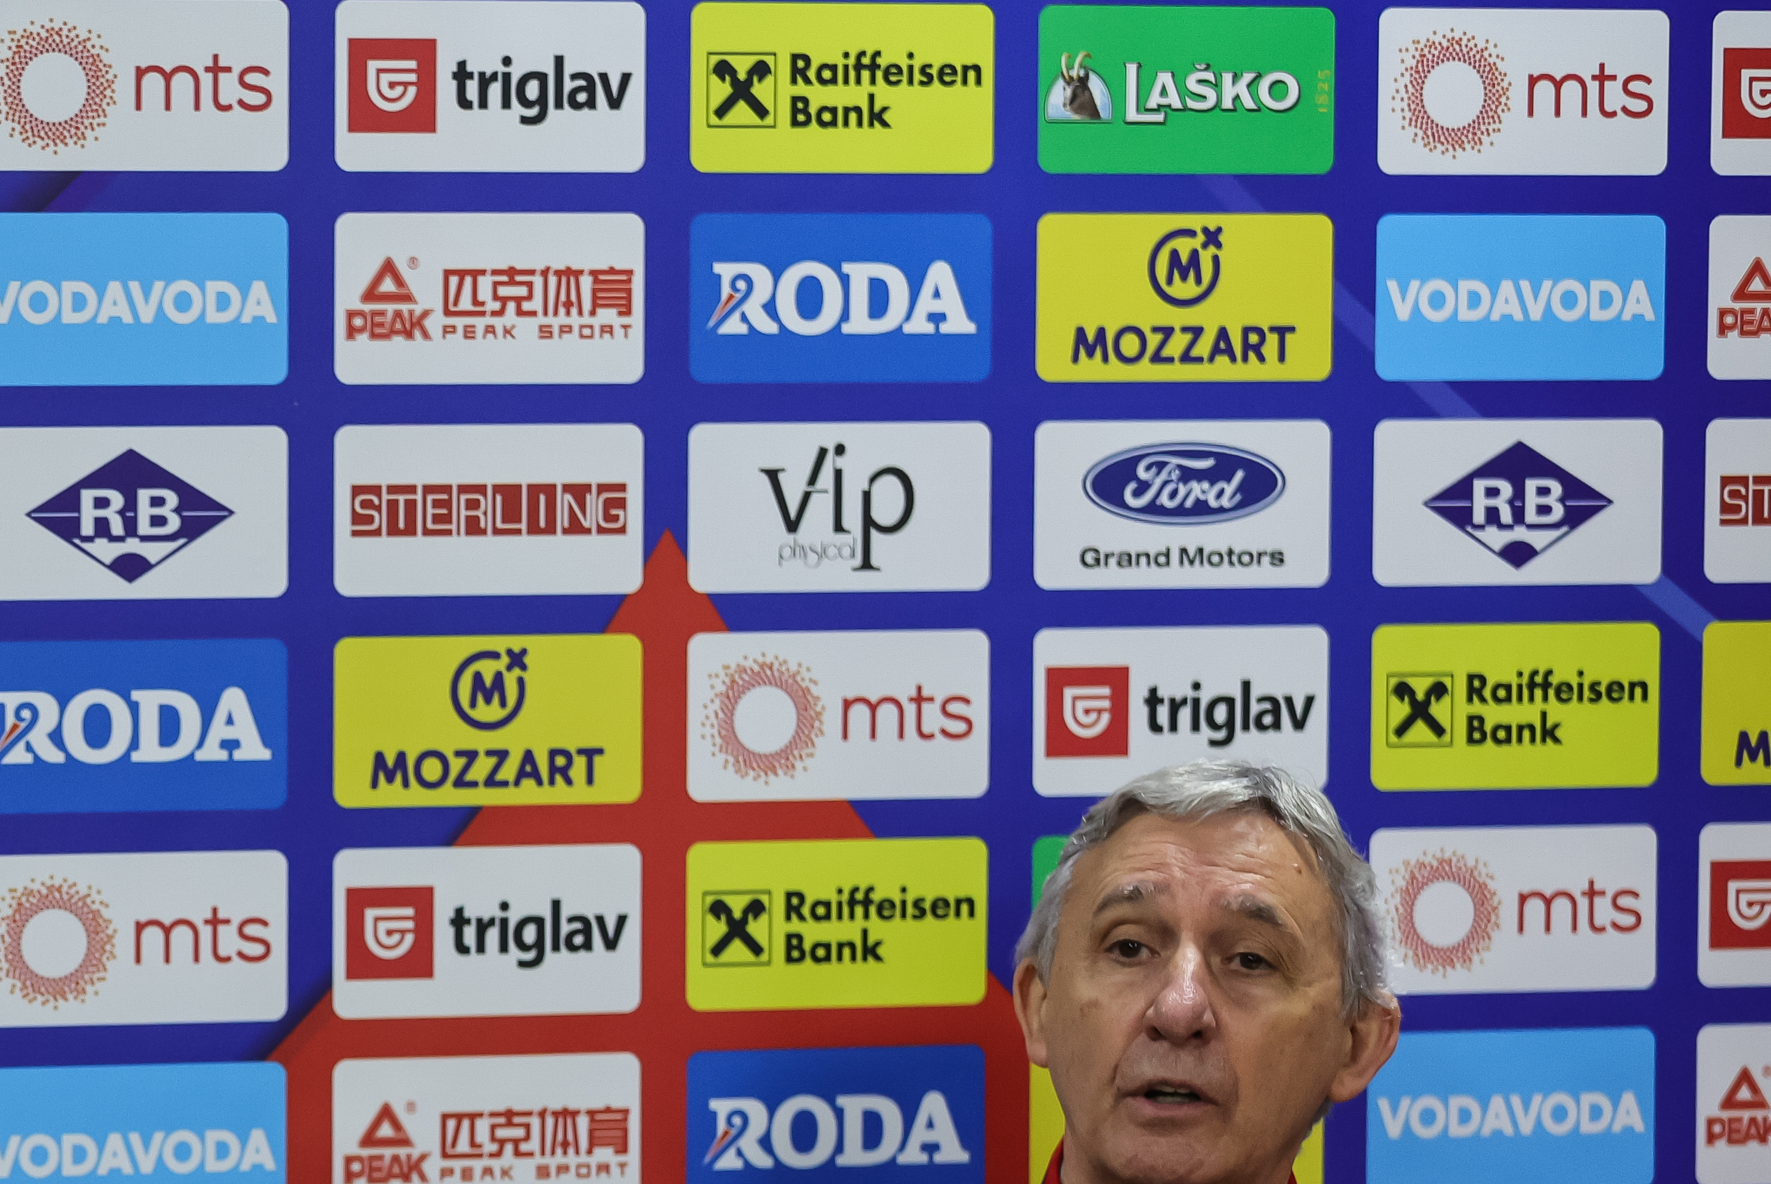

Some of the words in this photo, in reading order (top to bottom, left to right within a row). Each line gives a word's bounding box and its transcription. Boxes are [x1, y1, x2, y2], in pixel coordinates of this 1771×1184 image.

[135, 54, 272, 112] mts
[452, 55, 632, 125] triglav
[791, 50, 981, 87] Raiffeisen
[1528, 63, 1653, 119] mts
[791, 93, 891, 128] Bank
[443, 266, 634, 318] 匹克体育
[706, 260, 977, 336] RODA
[1387, 279, 1654, 322] VODAVODA
[345, 309, 434, 342] PEAK
[442, 325, 515, 340] PEAK
[538, 324, 631, 339] SPORT
[1072, 325, 1296, 364] MOZZART
[1124, 456, 1241, 508] Ford
[351, 483, 627, 537] STERLING
[1080, 547, 1170, 568] Grand
[1179, 547, 1284, 567] Motors
[1467, 669, 1648, 704] Raiffeisen
[842, 685, 973, 741] mts
[1144, 680, 1315, 747] triglav
[1467, 711, 1561, 745] Bank
[371, 748, 604, 789] MOZZART
[785, 886, 975, 922] Raiffeisen
[1518, 879, 1642, 934] mts
[135, 907, 271, 964] mts
[450, 899, 627, 968] triglav
[785, 928, 883, 964] Bank
[440, 1106, 629, 1160] 匹克体育
[703, 1091, 970, 1170] RODA
[1378, 1092, 1644, 1139] VODAVODA
[343, 1153, 430, 1184] PEAK
[440, 1166, 512, 1182] PEAK
[536, 1162, 627, 1180] SPORT
